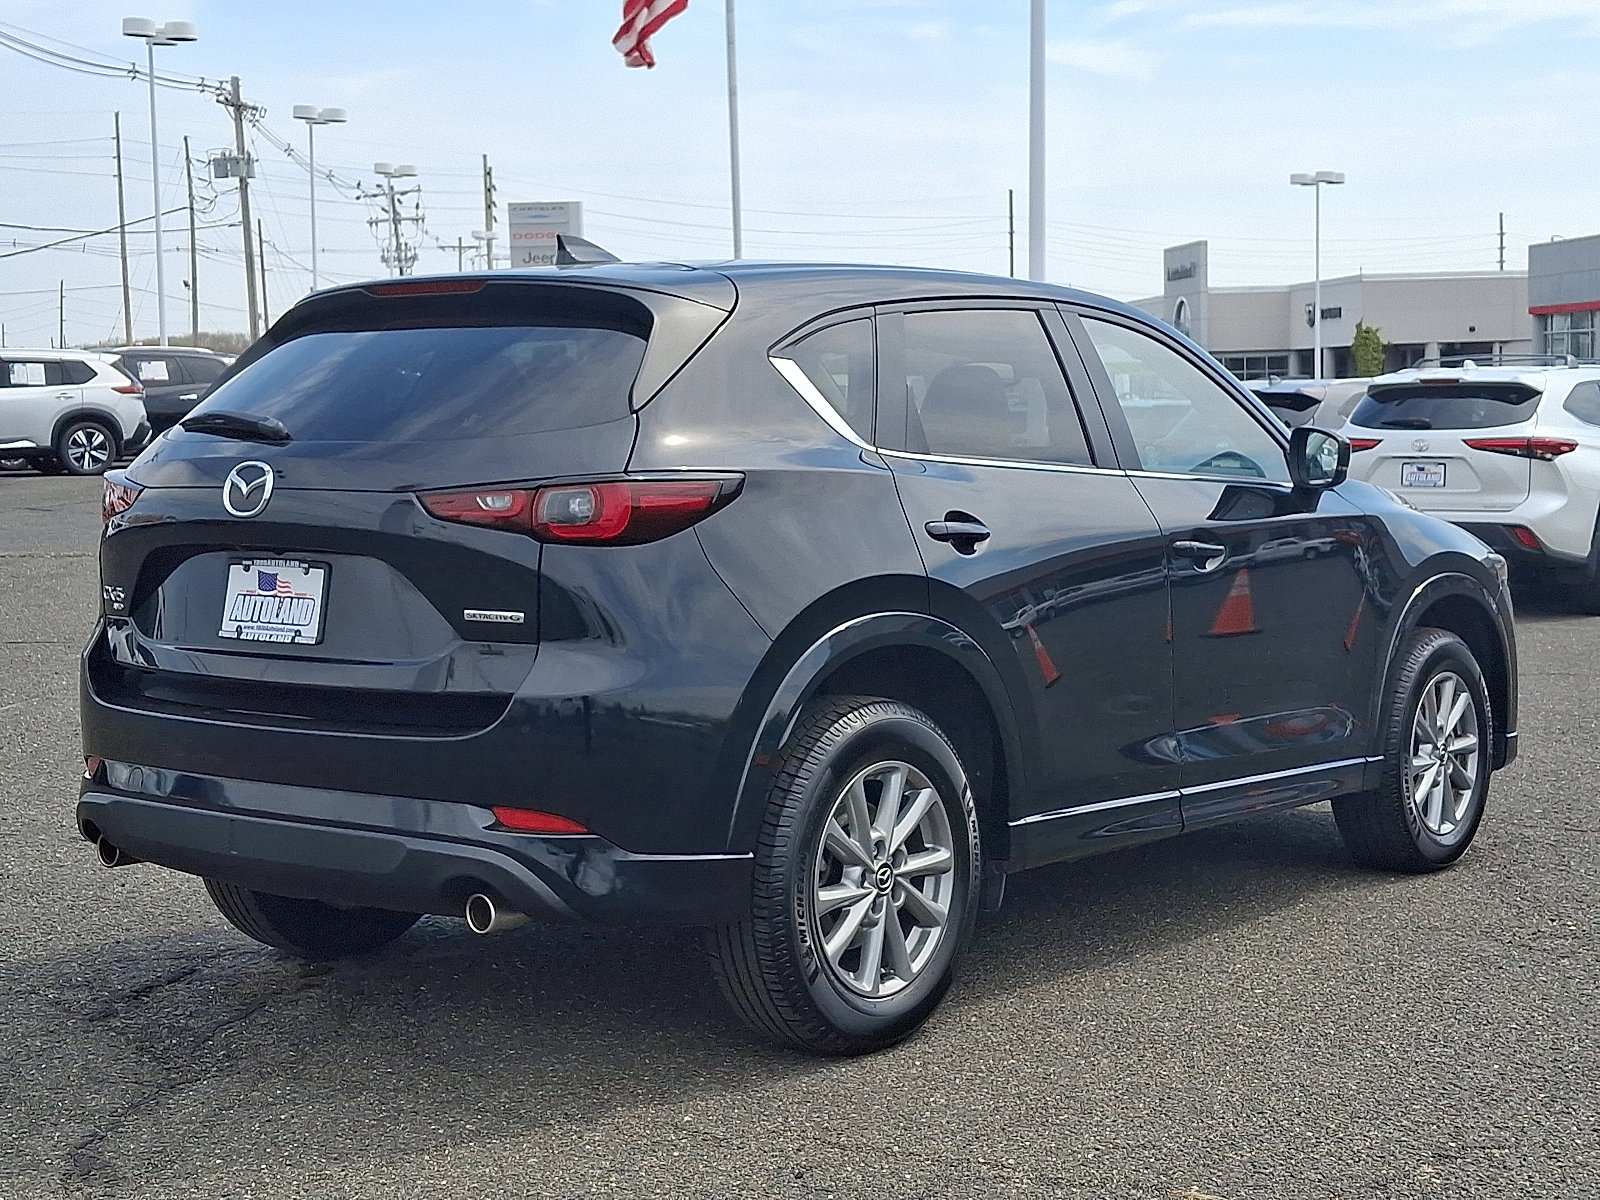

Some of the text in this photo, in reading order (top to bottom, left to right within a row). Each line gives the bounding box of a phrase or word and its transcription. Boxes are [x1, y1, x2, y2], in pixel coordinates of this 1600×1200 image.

[513, 231, 565, 239] DODG
[229, 594, 315, 626] AUTOLAND
[239, 632, 293, 643] AUTOLAND
